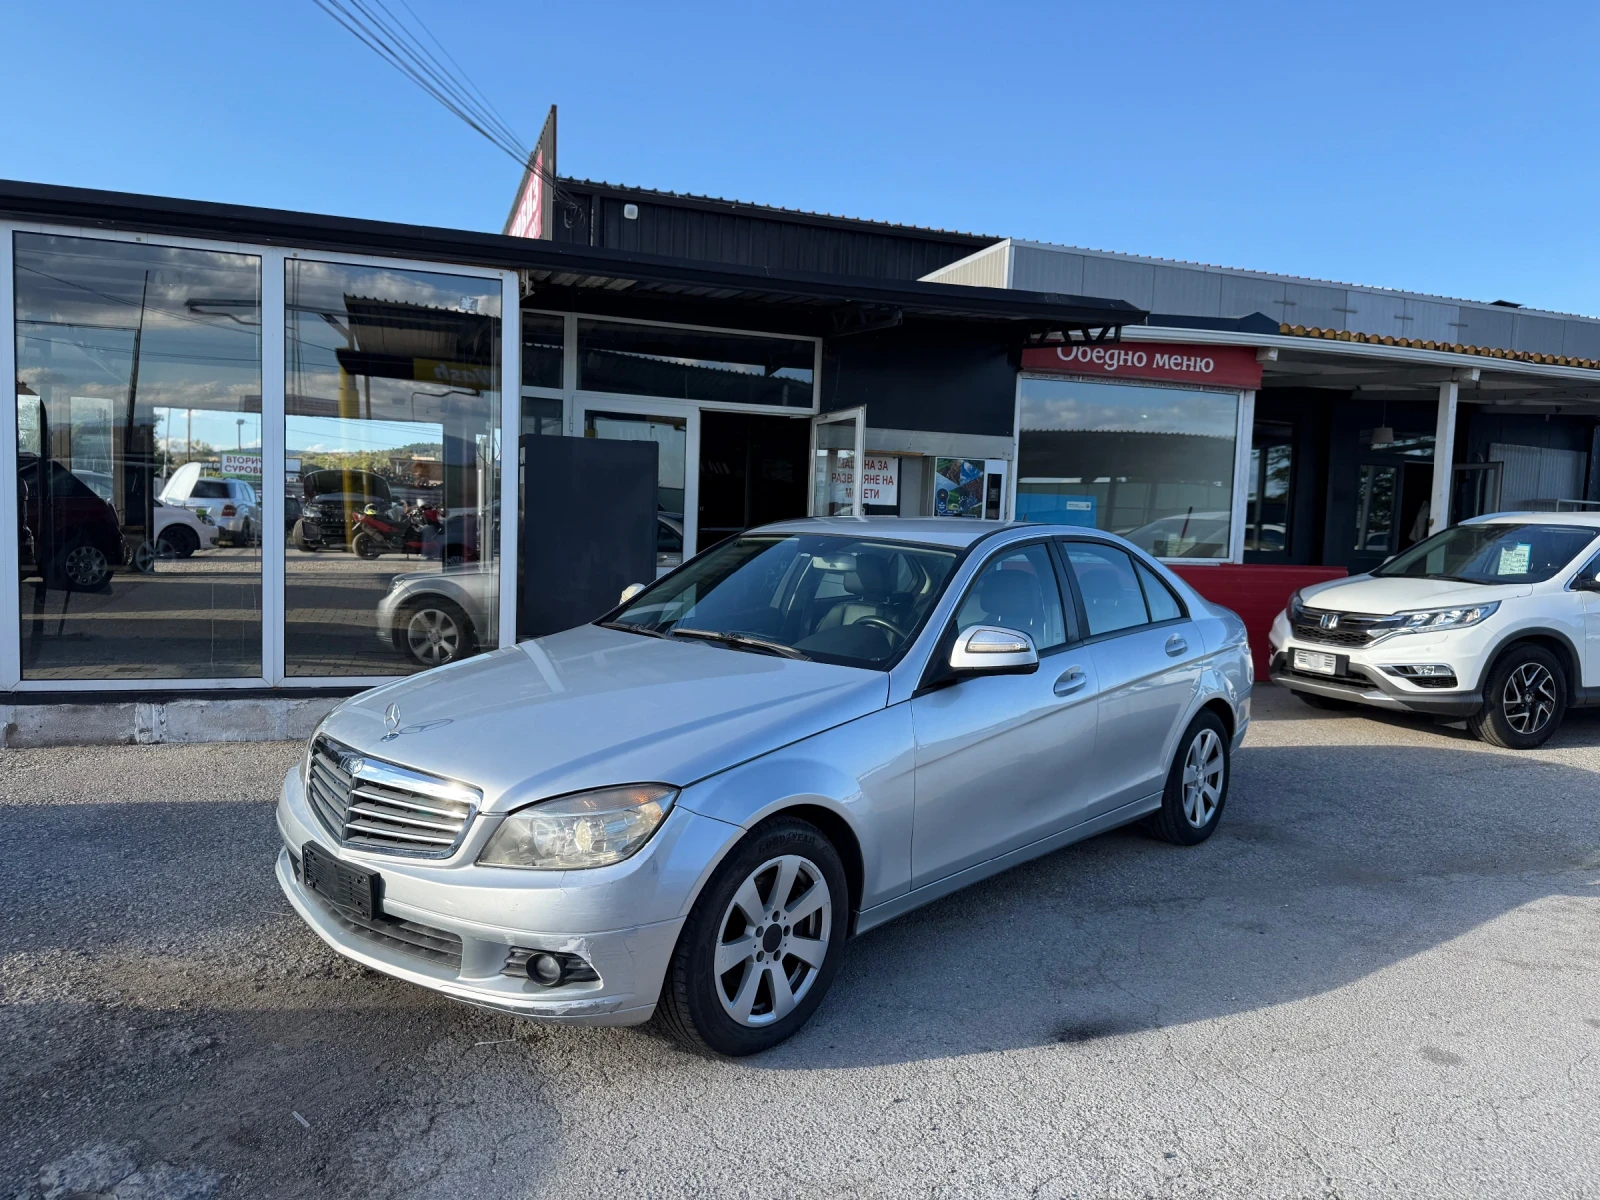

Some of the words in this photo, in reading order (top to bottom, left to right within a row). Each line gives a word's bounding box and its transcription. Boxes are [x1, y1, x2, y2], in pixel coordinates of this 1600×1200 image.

[1056, 346, 1147, 370] Обедно
[1152, 353, 1214, 373] меню
[877, 460, 888, 470] ЗА
[831, 473, 880, 485] РАЗВЯНЕ
[882, 475, 894, 485] НА
[845, 488, 880, 499] МЕТИ
